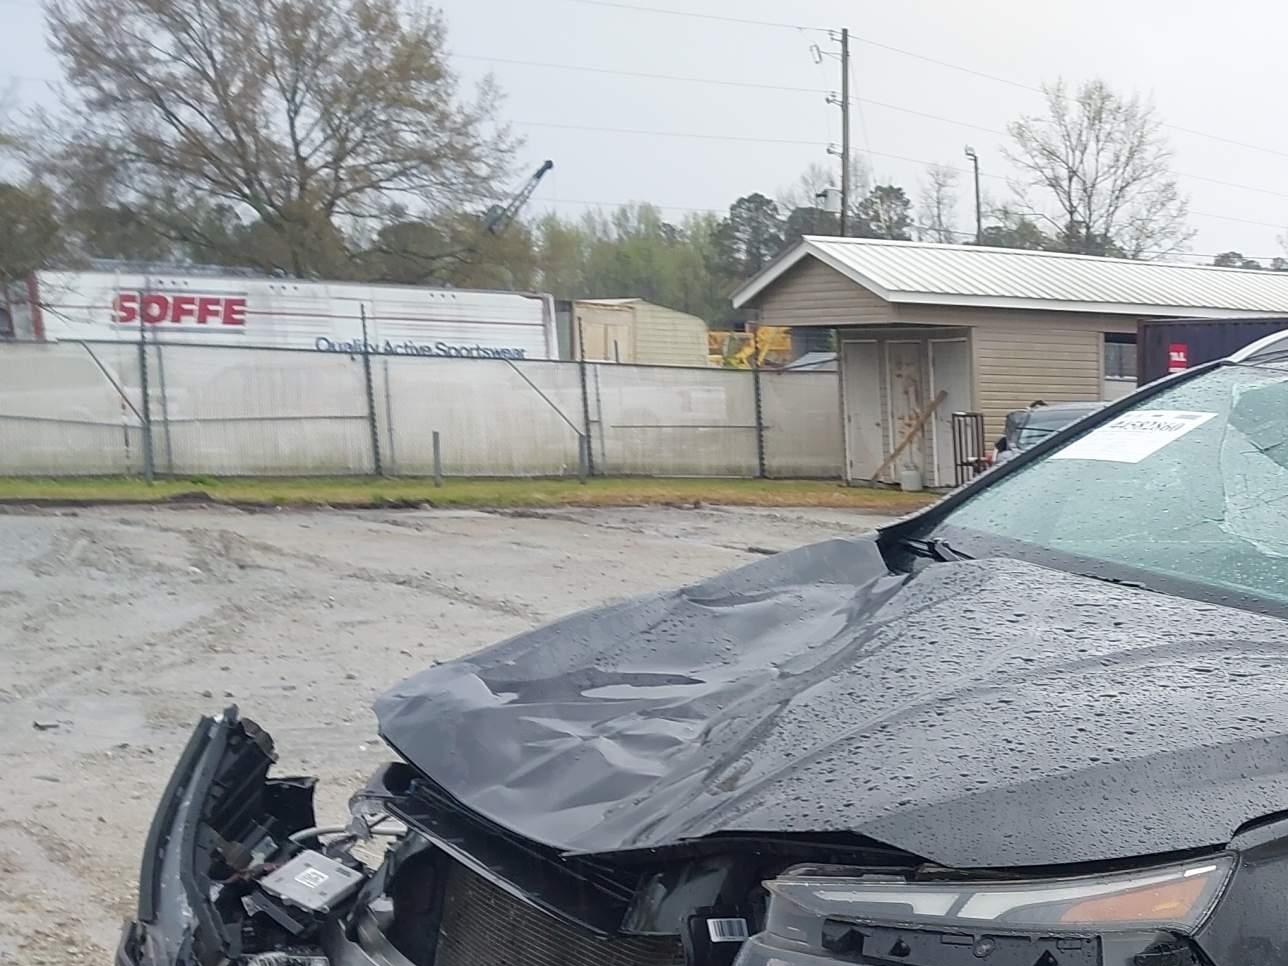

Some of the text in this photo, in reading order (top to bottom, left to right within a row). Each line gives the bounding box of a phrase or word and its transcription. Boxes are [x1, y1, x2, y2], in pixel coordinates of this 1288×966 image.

[111, 294, 246, 326] SOFFE
[315, 337, 525, 359] Quality Active Sportswear
